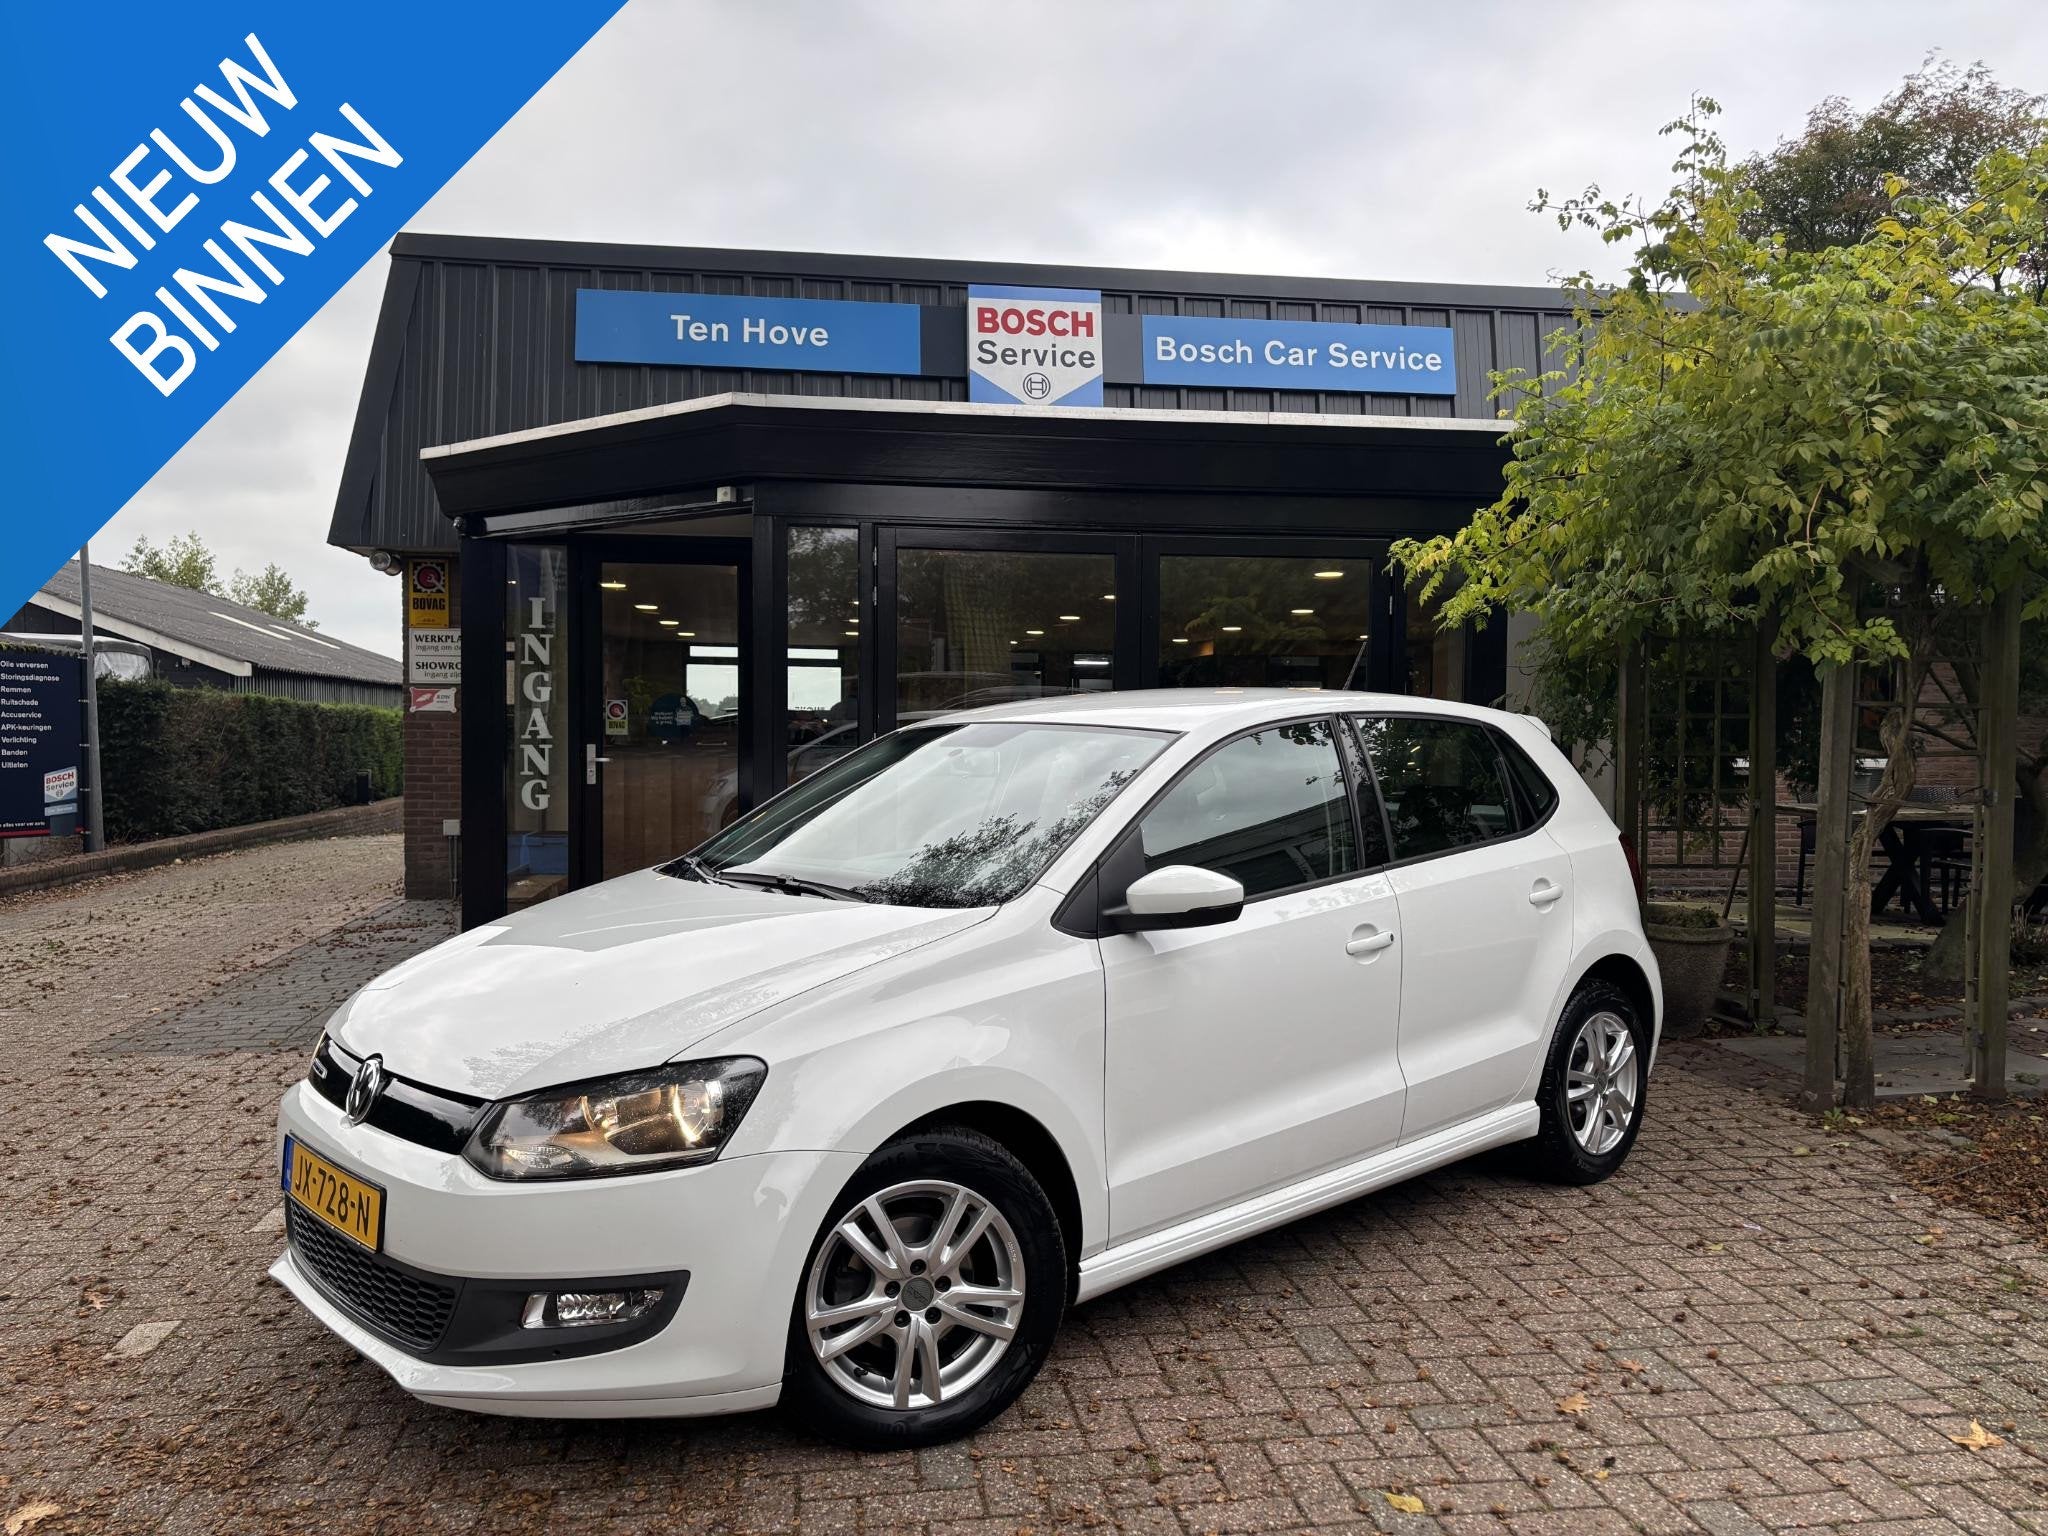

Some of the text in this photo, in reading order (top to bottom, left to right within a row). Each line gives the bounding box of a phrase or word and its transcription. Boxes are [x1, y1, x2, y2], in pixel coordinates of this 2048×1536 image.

[670, 314, 830, 347] Ten Hove
[976, 306, 1094, 338] BOSCH
[976, 340, 1096, 369] Service
[1155, 336, 1443, 372] Bosch Car Service
[412, 597, 446, 610] BOVAG
[0, 685, 32, 693] Remmen
[519, 596, 554, 811] INGANG
[46, 771, 75, 785] BOSCH
[46, 780, 75, 792] Service
[294, 1155, 372, 1237] JX-728-N
